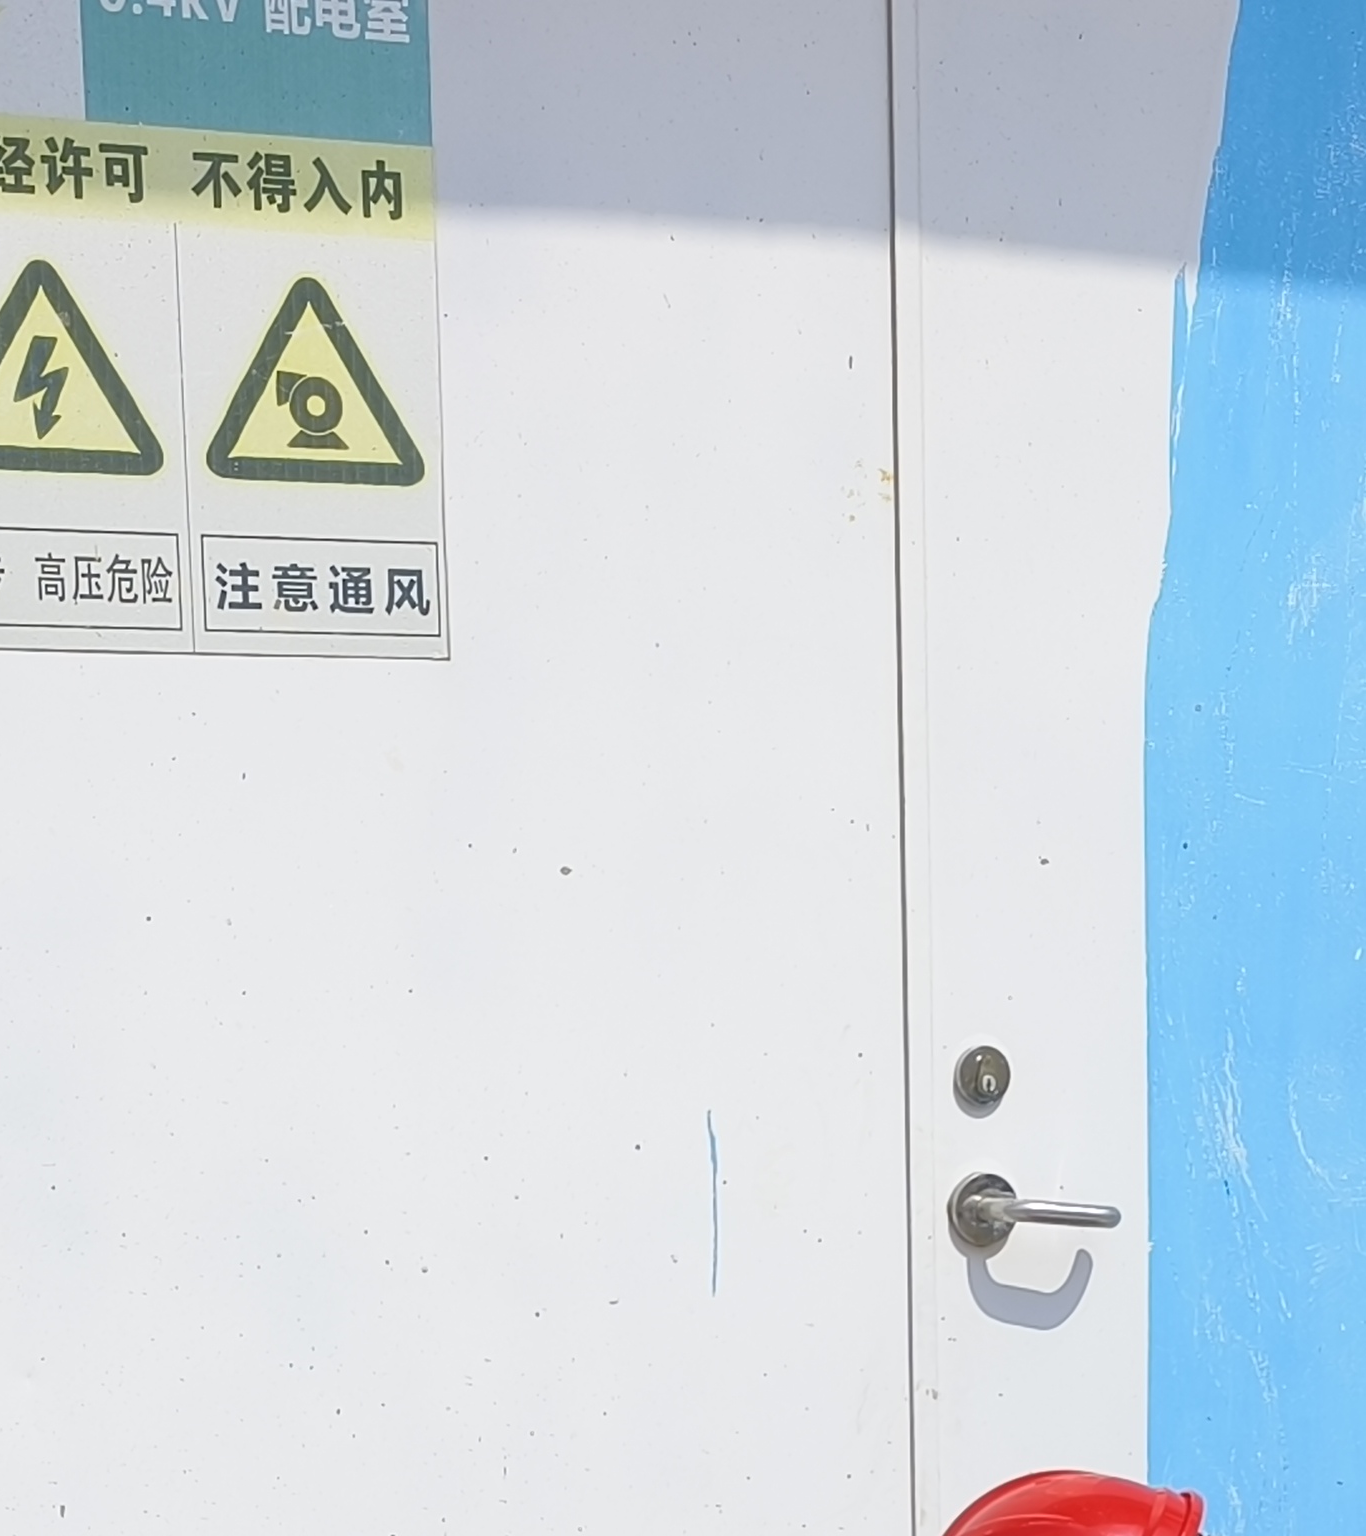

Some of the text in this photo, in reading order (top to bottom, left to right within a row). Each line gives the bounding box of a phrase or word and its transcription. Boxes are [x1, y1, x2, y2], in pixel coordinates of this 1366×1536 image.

[265, 0, 411, 43] 配电室
[191, 150, 405, 221] 不得入内
[35, 551, 174, 605] 高压危险
[215, 561, 431, 616] 注意通风
